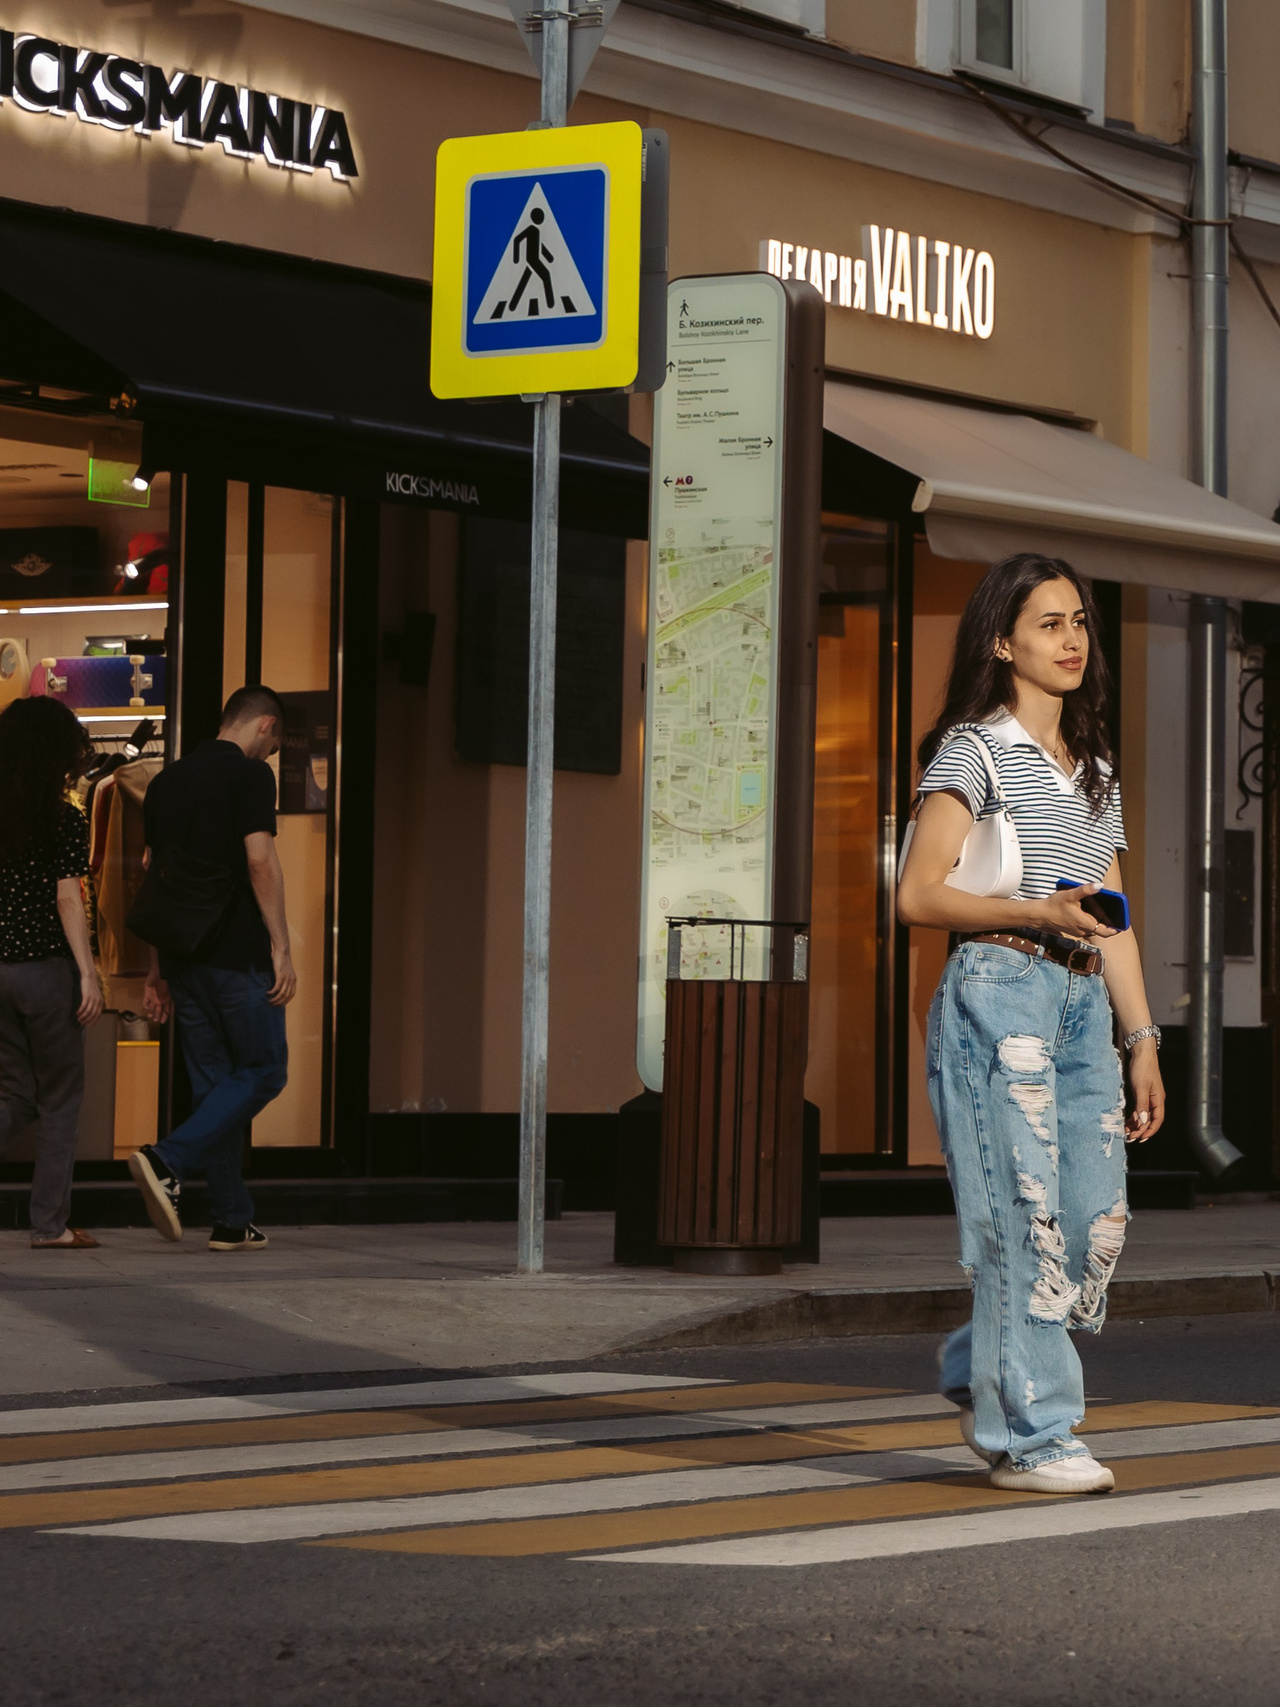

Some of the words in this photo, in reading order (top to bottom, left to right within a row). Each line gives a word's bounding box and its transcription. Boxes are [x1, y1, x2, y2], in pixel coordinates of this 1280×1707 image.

[766, 238, 867, 311] ПЕКАРНЯ
[868, 223, 996, 340] VALIKO
[679, 320, 687, 329] Б.
[689, 317, 744, 328] Козихинский
[746, 317, 765, 326] пер.
[386, 471, 479, 505] KICKSMANIA
